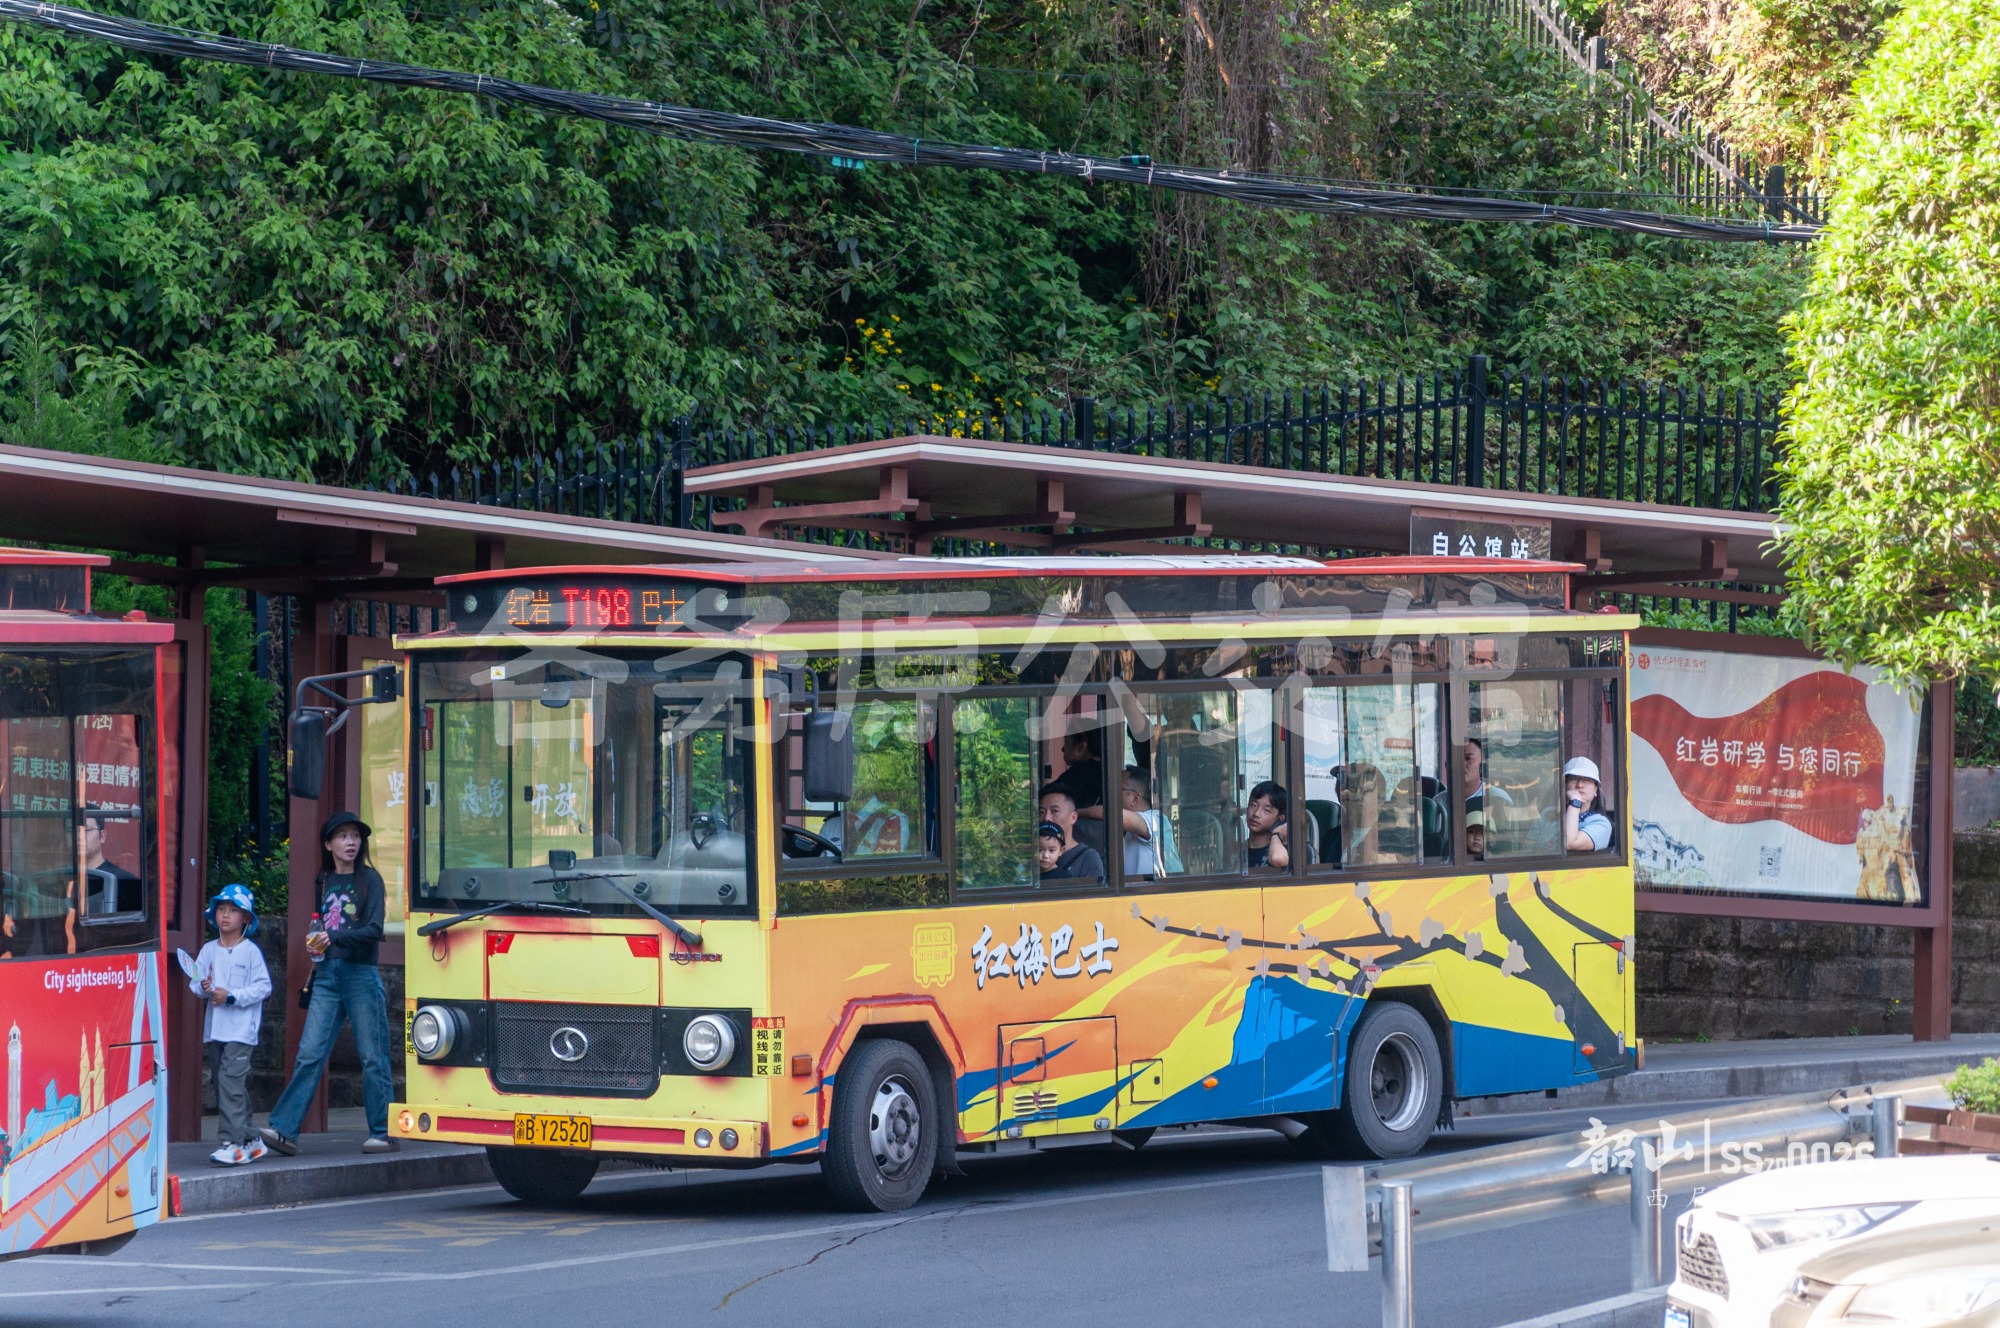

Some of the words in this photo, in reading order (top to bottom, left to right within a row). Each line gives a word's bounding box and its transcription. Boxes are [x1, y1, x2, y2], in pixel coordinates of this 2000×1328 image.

[1433, 532, 1529, 559] 白公馆站
[508, 589, 551, 626] 红岩
[561, 588, 631, 626] T198
[642, 589, 686, 626] 巴士
[1676, 736, 1766, 769] 红岩研学
[1777, 744, 1862, 778] 与您同行
[531, 781, 579, 820] 开放
[919, 950, 949, 962] 出行品牌
[972, 920, 1119, 990] 红梅巴士
[44, 970, 64, 993] City
[66, 966, 124, 992] sightseeing
[766, 1018, 784, 1028] 危险
[756, 1030, 769, 1075] 视线盲区
[772, 1030, 782, 1075] 请勿靠近
